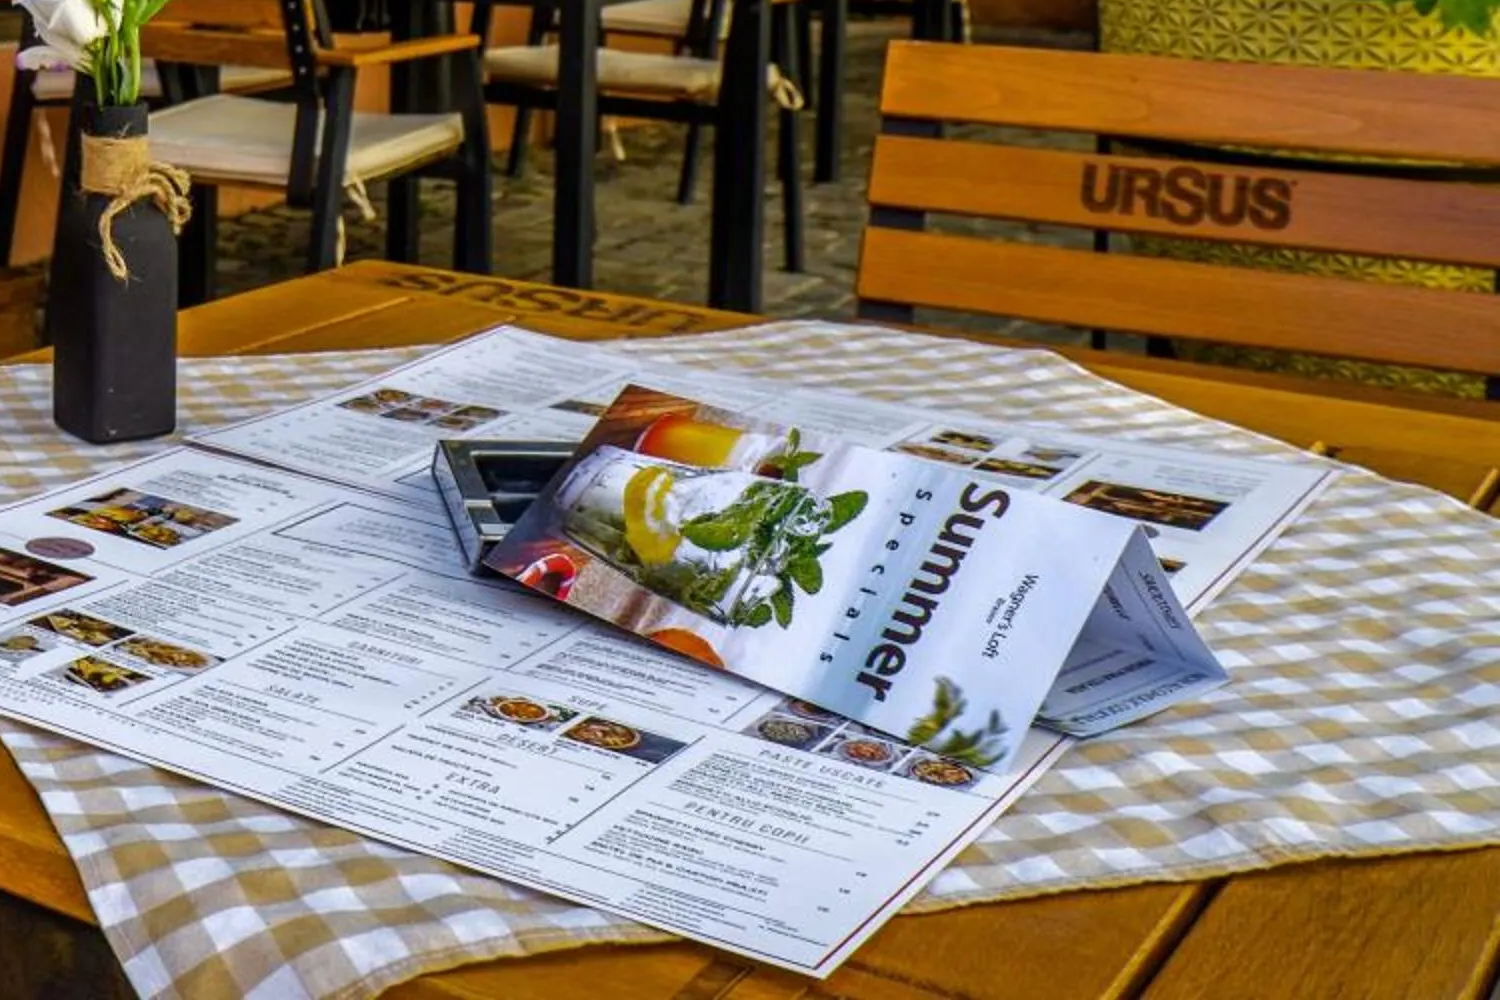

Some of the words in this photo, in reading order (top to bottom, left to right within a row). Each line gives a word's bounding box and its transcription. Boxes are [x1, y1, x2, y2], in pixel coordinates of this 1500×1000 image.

[1080, 161, 1294, 232] URSUS
[820, 488, 933, 664] Specials
[855, 482, 1011, 703] Summer
[998, 574, 1039, 630] Wagner's
[981, 632, 1007, 659] Loft
[445, 771, 502, 795] EXTRA
[757, 748, 813, 771] PASTE
[819, 764, 887, 789] USCATE
[683, 801, 754, 828] PENTRU
[758, 823, 811, 844] COPII
